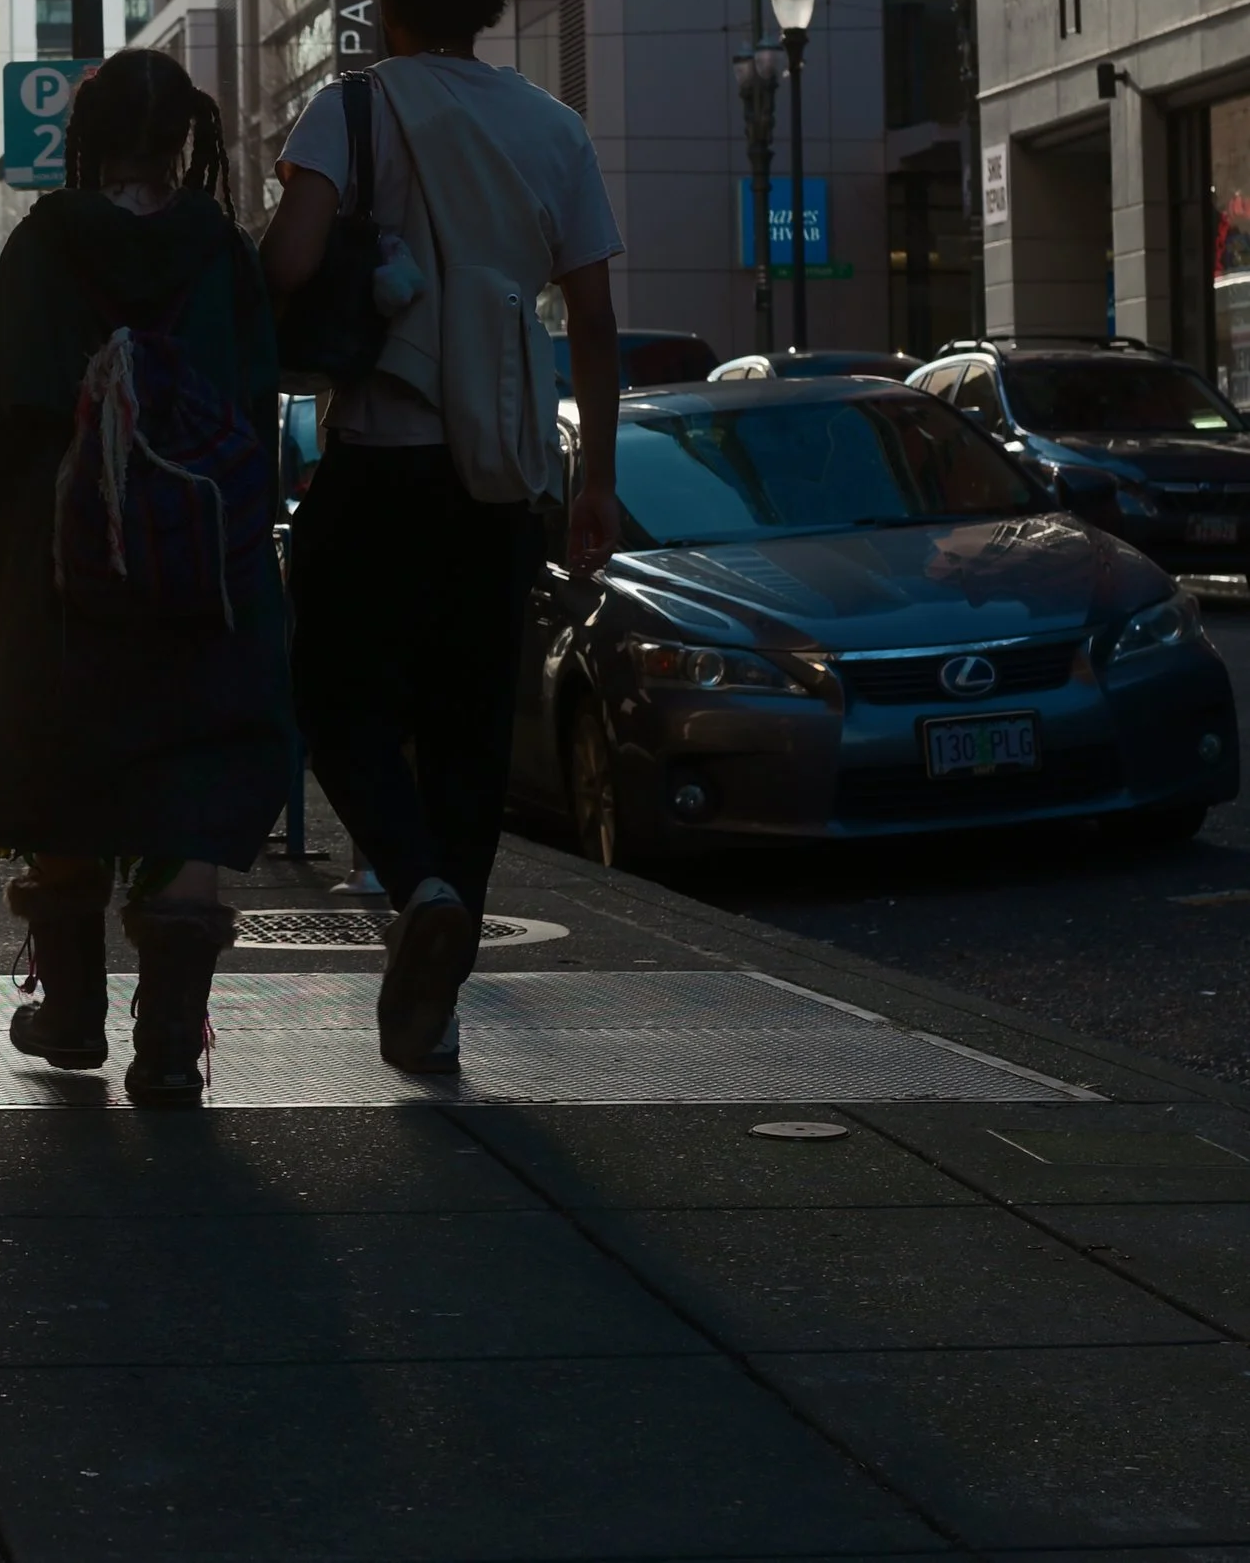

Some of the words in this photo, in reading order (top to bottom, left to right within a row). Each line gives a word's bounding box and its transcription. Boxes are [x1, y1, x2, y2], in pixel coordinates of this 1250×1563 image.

[35, 75, 60, 110] P
[33, 123, 64, 167] 2
[935, 733, 975, 764] 130
[990, 728, 1033, 759] PLG
